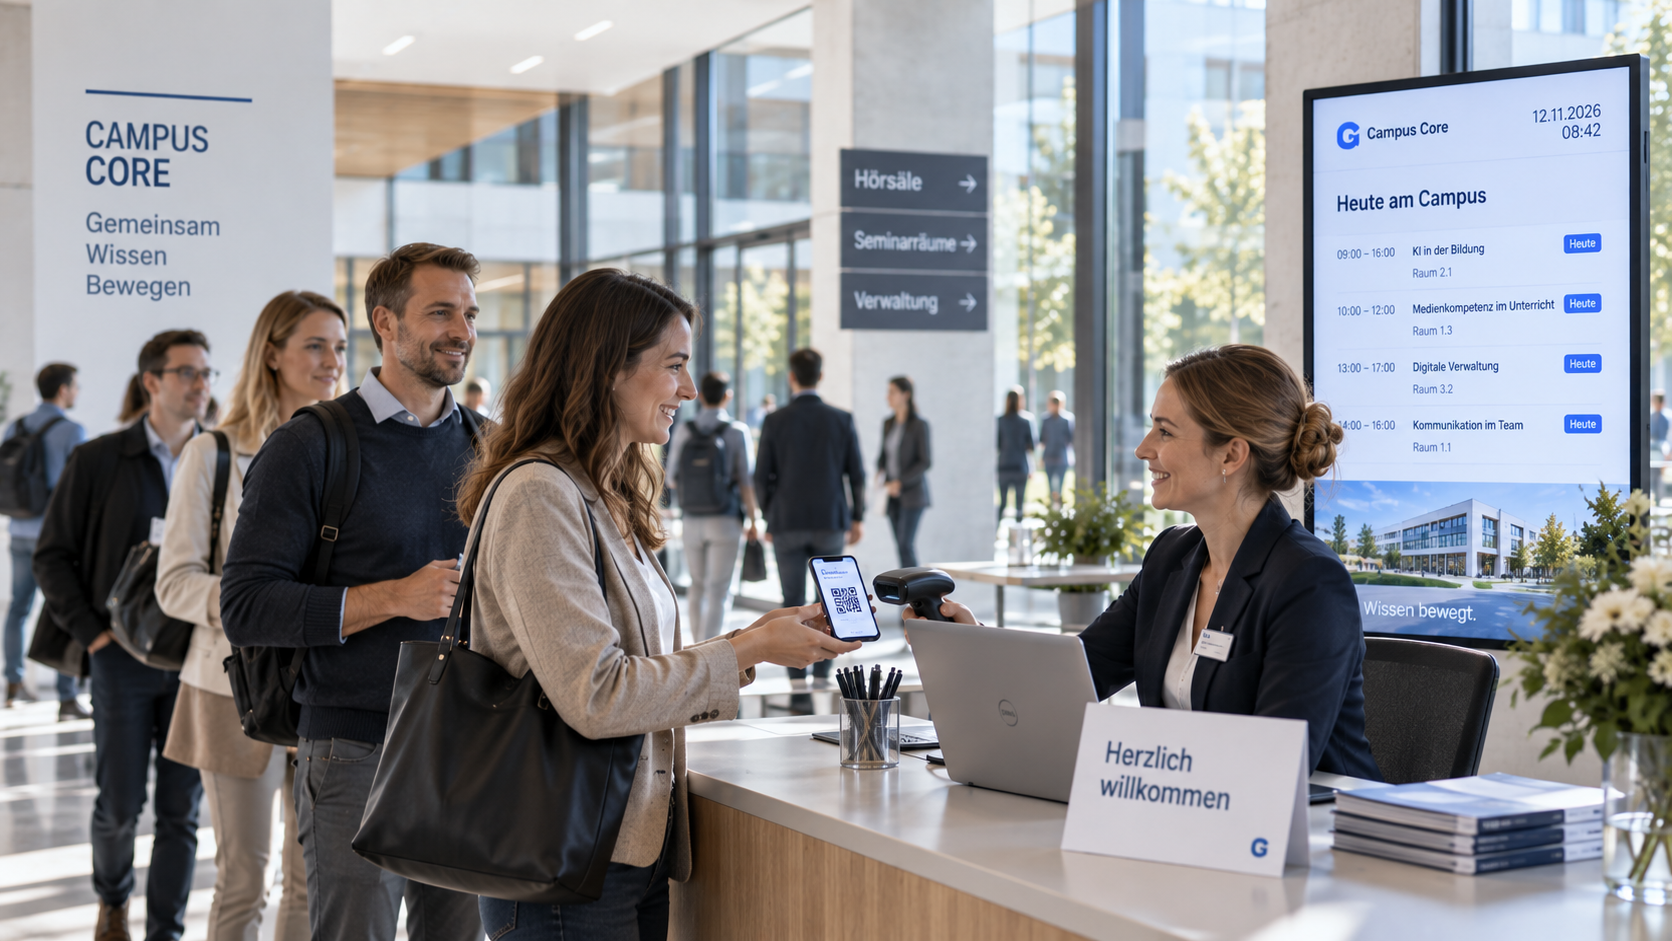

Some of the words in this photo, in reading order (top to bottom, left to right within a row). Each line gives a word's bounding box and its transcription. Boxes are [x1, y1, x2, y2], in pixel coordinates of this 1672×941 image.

[1533, 103, 1601, 123] 12.11.2026
[86, 120, 209, 153] CAMPUS
[1337, 121, 1360, 150] G
[1367, 124, 1416, 142] Campus
[1420, 121, 1448, 135] Core
[1562, 123, 1601, 140] 08:42
[86, 155, 171, 187] CORE
[854, 169, 923, 191] Hörsäle
[1337, 194, 1384, 212] Heute
[1389, 193, 1414, 209] am
[1418, 190, 1486, 209] Campus
[86, 211, 220, 236] Gemeinsam
[854, 230, 957, 253] Seminarräume
[1413, 246, 1422, 256] KI
[1424, 245, 1432, 256] in
[1434, 245, 1448, 255] der
[1451, 243, 1485, 256] Bildung
[1569, 238, 1596, 249] Heute
[86, 243, 167, 266] Wissen
[1337, 248, 1361, 260] 09:00
[1372, 247, 1395, 258] 16:00
[1413, 268, 1438, 279] Raum
[1439, 267, 1452, 278] 2.1
[86, 274, 190, 301] Bewegen
[854, 291, 938, 315] Verwaltung
[1337, 306, 1361, 316] 10:00
[1372, 305, 1395, 315] 12:00
[1413, 301, 1494, 315] Medienkompetenz
[1496, 301, 1507, 312] im
[1509, 299, 1555, 311] Unterricht
[1569, 298, 1596, 309] Heute
[1413, 326, 1438, 336] Raum
[1440, 325, 1453, 336] 1.3
[1337, 363, 1361, 373] 13:00
[1372, 362, 1395, 373] 17:00
[1413, 362, 1446, 374] Digitale
[1448, 361, 1499, 374] Verwaltung
[1569, 358, 1596, 369] Heute
[1413, 384, 1438, 394] Raum
[1440, 384, 1453, 394] 3.2
[1372, 420, 1395, 430] 16:00
[1413, 419, 1483, 430] Kommunikation
[1485, 419, 1496, 430] im
[1498, 419, 1523, 430] Team
[1569, 419, 1596, 429] Heute
[1413, 442, 1438, 452] Raum
[1440, 442, 1452, 452] 1.1
[1363, 600, 1414, 618] Wissen
[1418, 602, 1477, 624] bewegt.
[1105, 741, 1193, 772] Herzlich
[1100, 775, 1230, 811] willkommen
[1250, 838, 1269, 858] G
